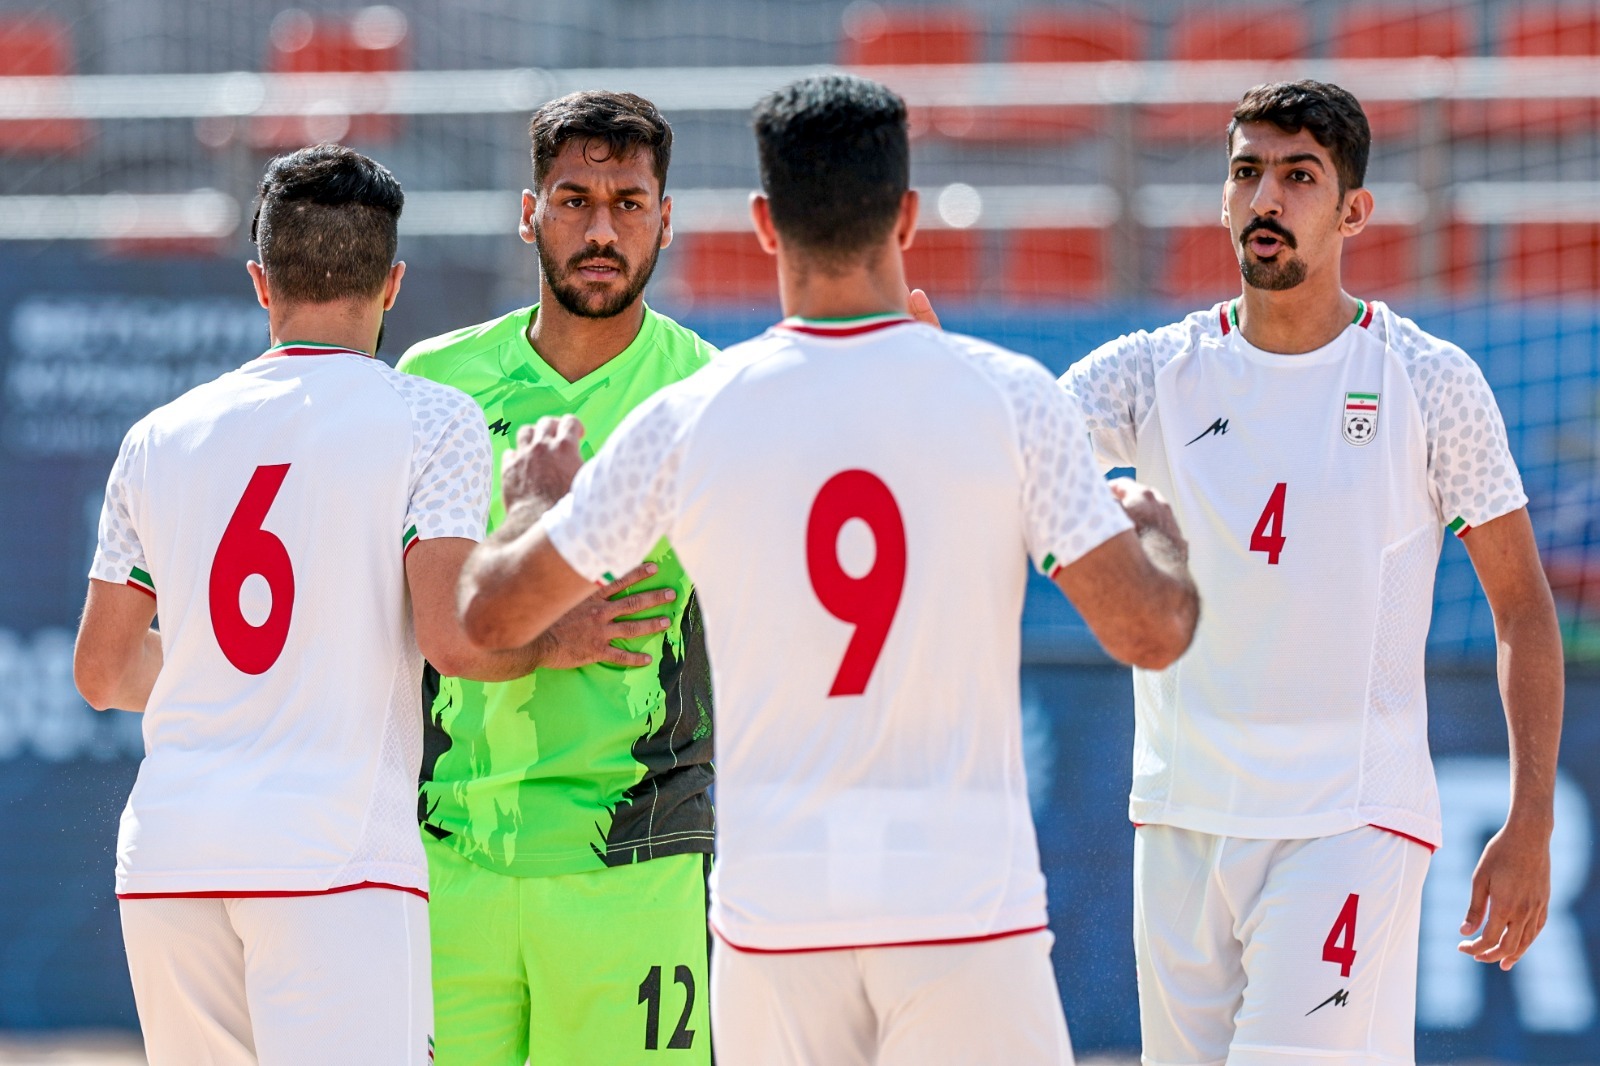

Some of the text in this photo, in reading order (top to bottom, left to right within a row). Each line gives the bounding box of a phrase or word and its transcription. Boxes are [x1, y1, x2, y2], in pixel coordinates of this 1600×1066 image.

[1249, 482, 1287, 565] 4
[209, 464, 294, 675] 6
[806, 469, 907, 698] 9
[1322, 893, 1360, 978] 4
[637, 965, 696, 1051] 12
